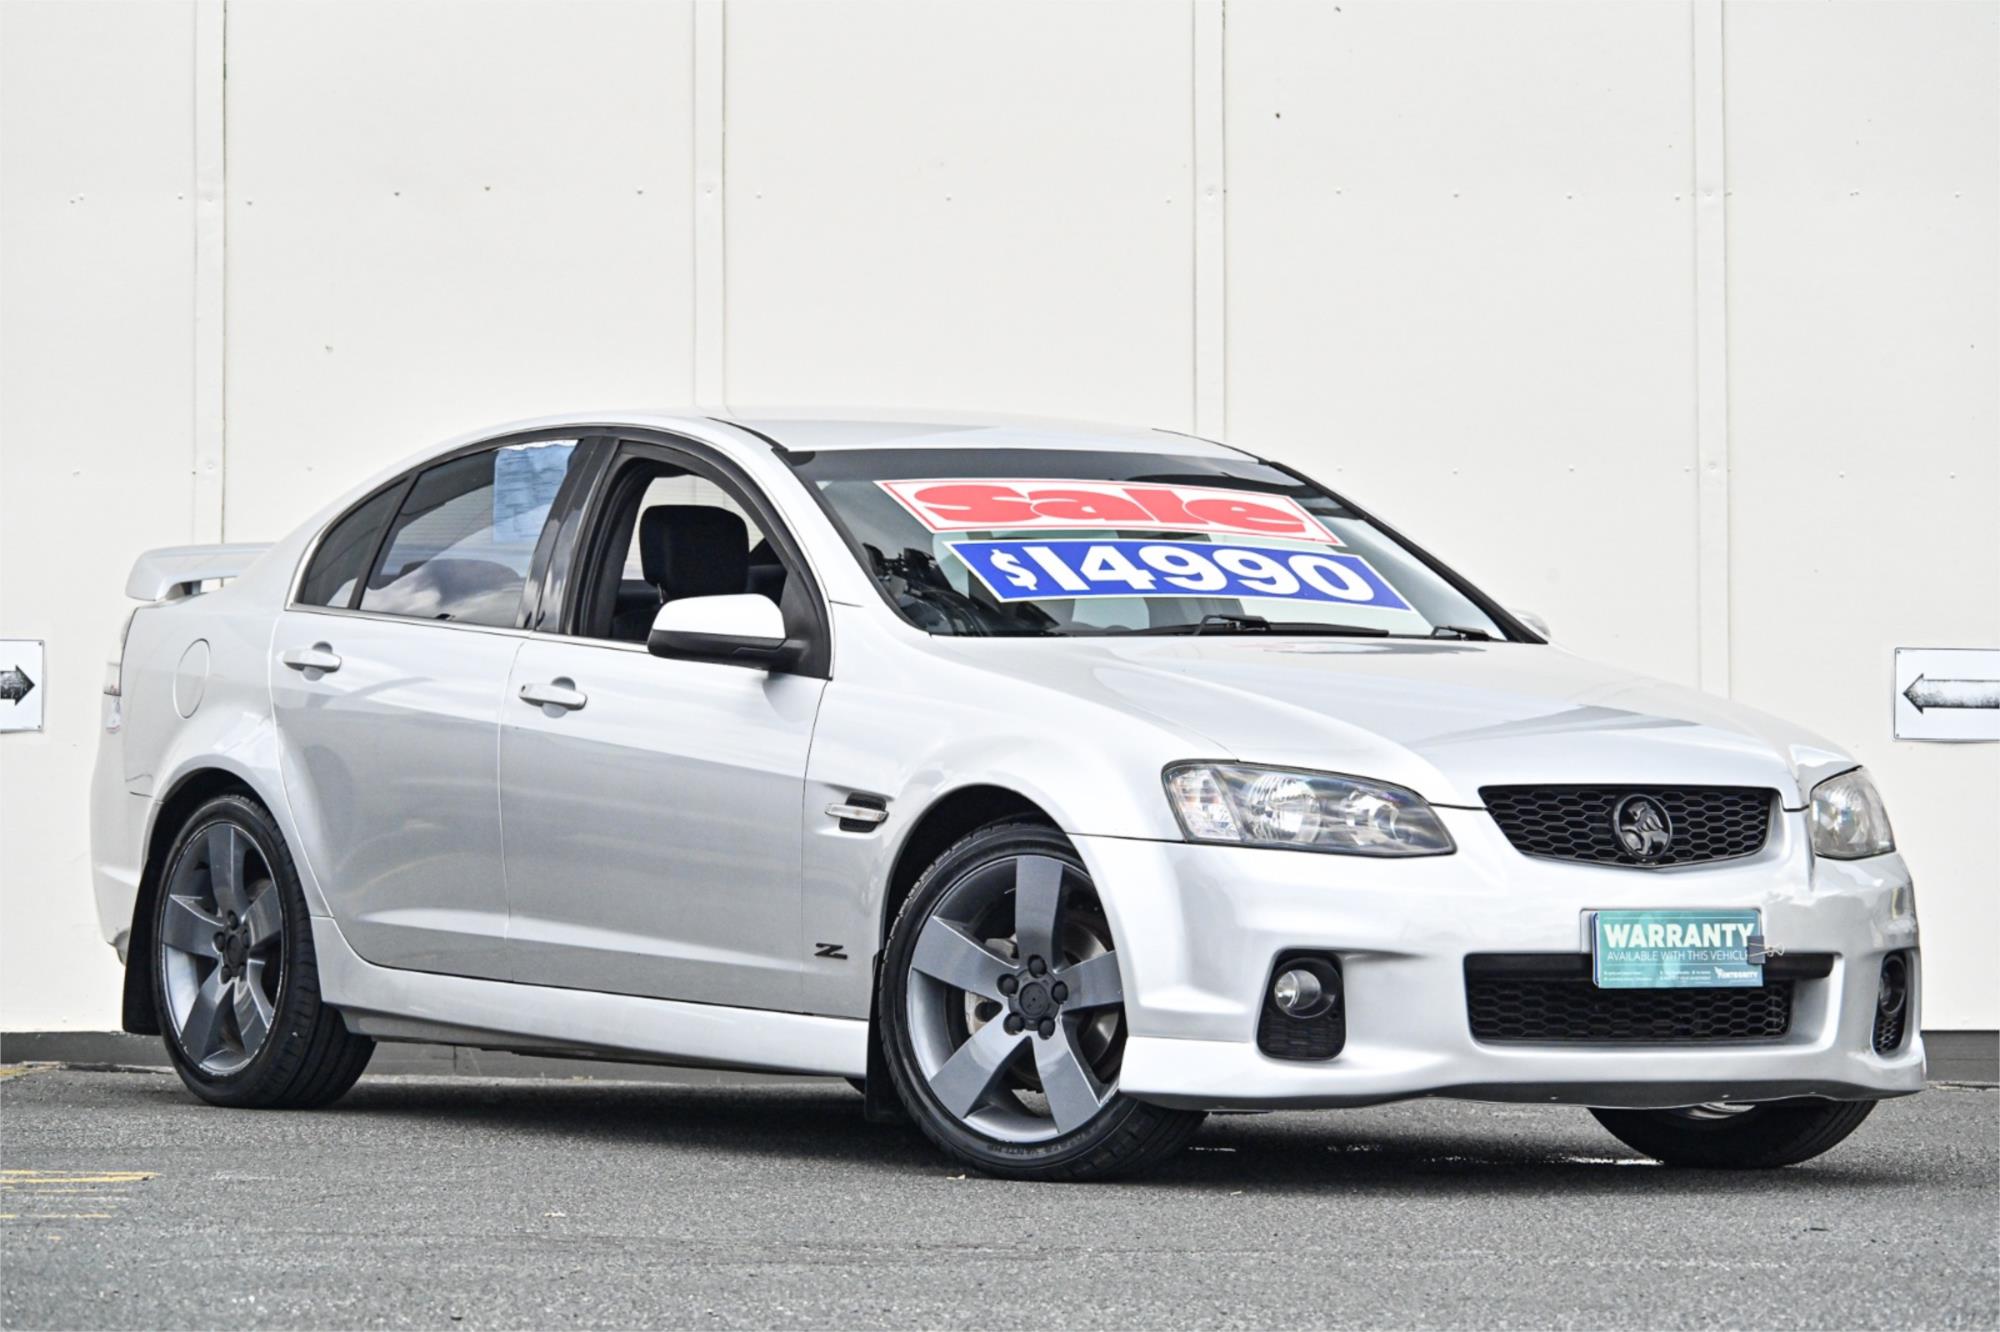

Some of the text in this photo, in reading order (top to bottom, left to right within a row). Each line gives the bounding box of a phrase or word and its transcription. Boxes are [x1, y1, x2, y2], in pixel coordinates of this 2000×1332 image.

[990, 545, 1375, 601] $14990
[1603, 923, 1755, 948] WARRANTY
[1607, 950, 1657, 961] AVAILABLE
[1661, 950, 1685, 961] WITH
[1688, 950, 1708, 961] THIS
